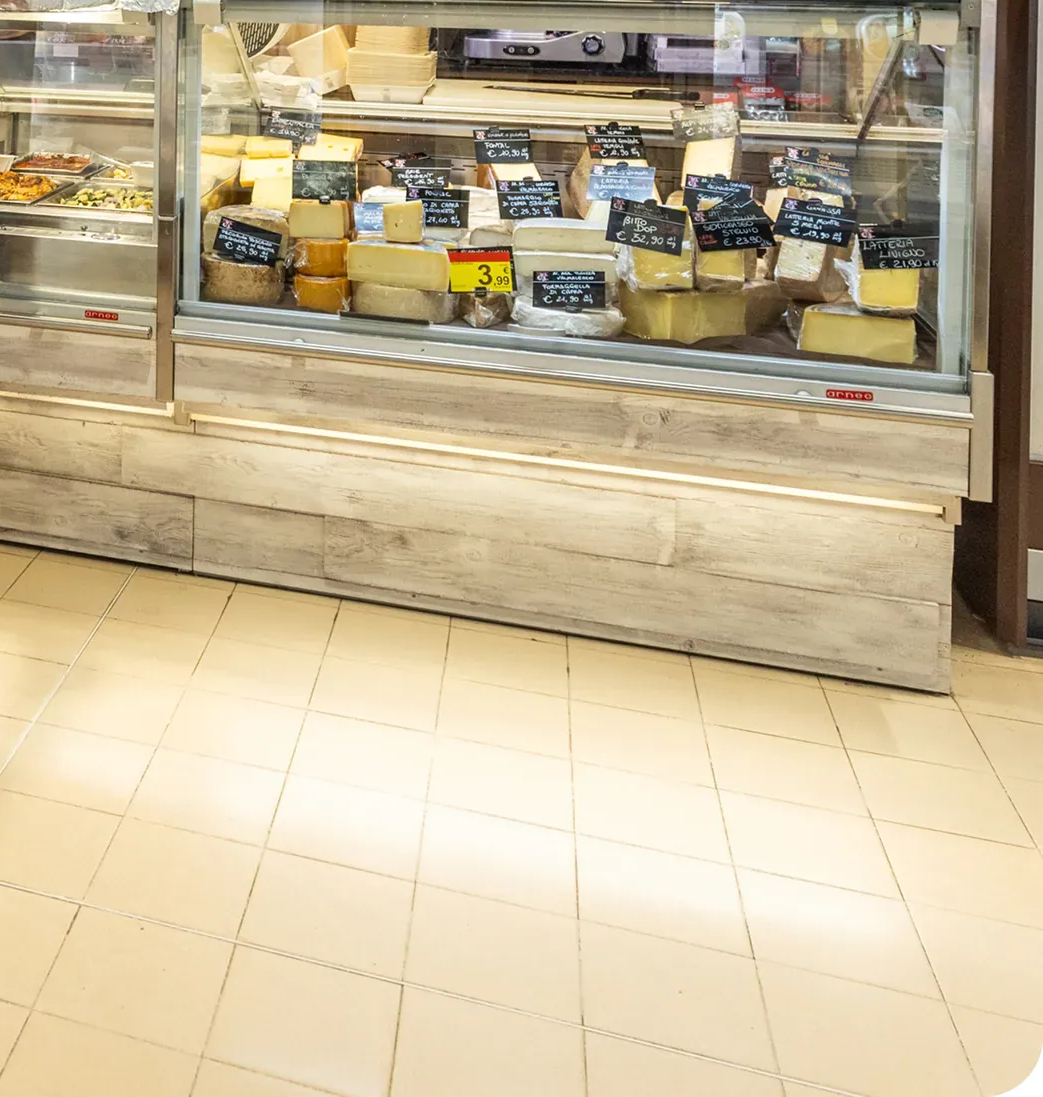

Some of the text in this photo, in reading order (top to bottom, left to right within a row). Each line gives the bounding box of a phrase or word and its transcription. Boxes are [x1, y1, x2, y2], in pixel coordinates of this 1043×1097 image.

[633, 224, 658, 234] DOP
[615, 230, 664, 245] € 32,90
[224, 241, 234, 250] €
[863, 238, 914, 251] LATTERIA
[879, 248, 926, 259] LIVIGNO
[878, 260, 889, 269] €
[477, 264, 493, 286] 3
[503, 266, 509, 275] €
[542, 295, 553, 304] €
